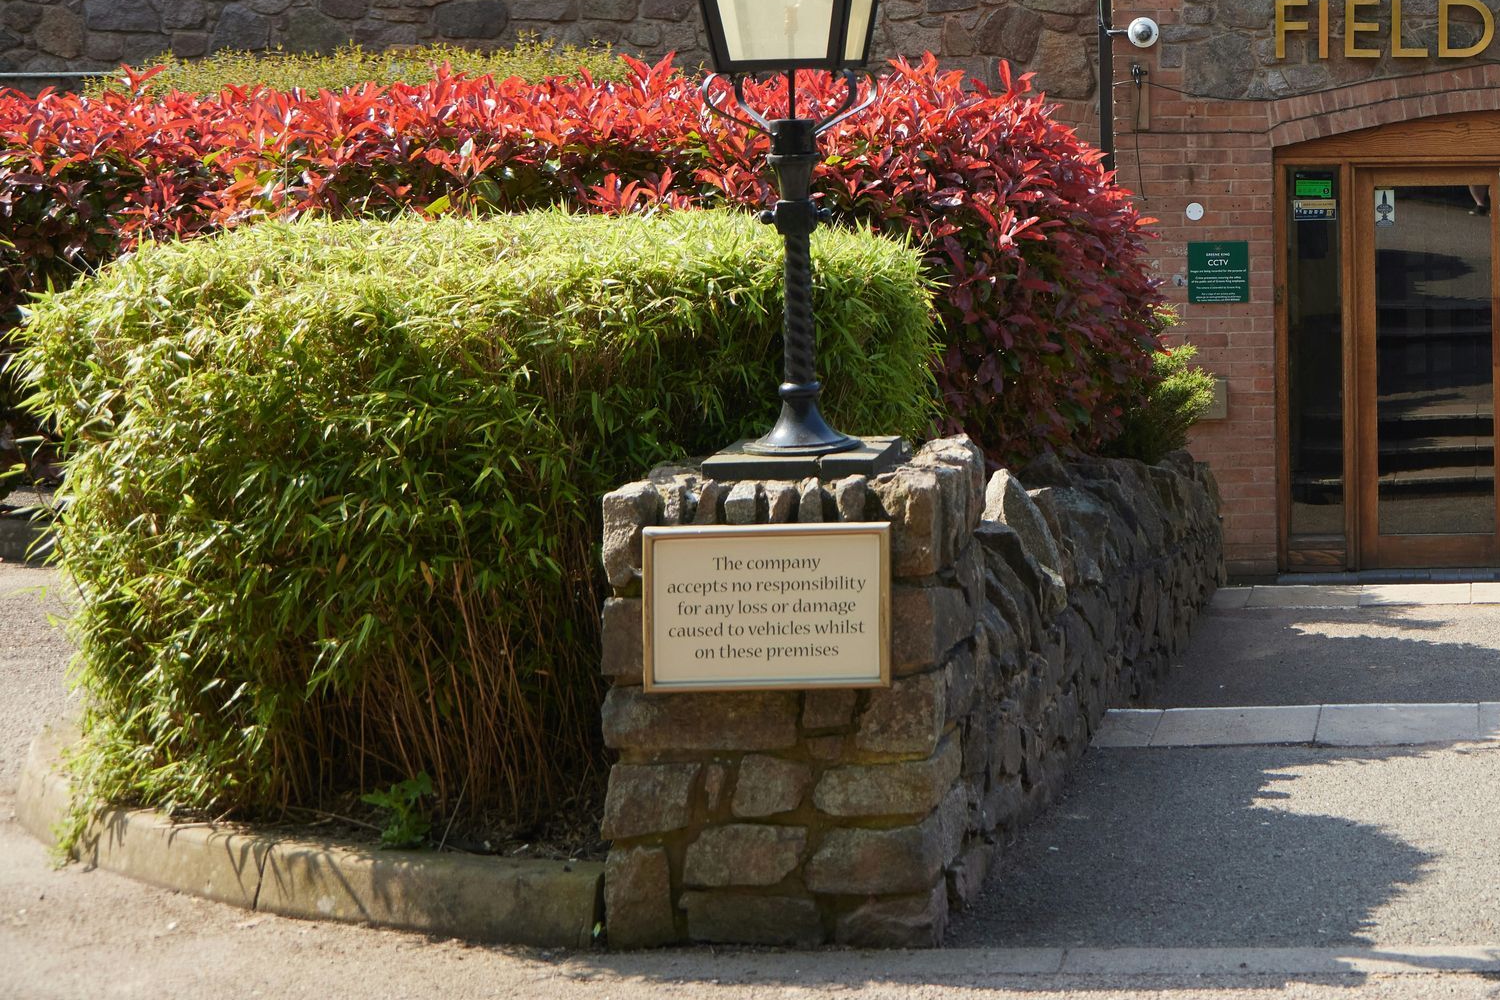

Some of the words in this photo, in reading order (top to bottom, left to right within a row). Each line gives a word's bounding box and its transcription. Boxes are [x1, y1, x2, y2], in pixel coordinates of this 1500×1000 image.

[712, 556, 743, 571] The
[746, 557, 821, 572] company
[667, 580, 728, 596] accepts
[732, 580, 752, 593] no
[756, 576, 866, 594] responsibility
[678, 601, 701, 616] for
[705, 603, 734, 618] any
[738, 600, 767, 614] loss
[771, 602, 789, 614] or
[793, 599, 856, 616] damage
[668, 622, 723, 638] caused
[728, 624, 744, 637] to
[748, 620, 810, 636] vehicles
[815, 620, 864, 635] whilst
[694, 647, 715, 660] on
[719, 644, 762, 659] these
[766, 643, 839, 661] premises
